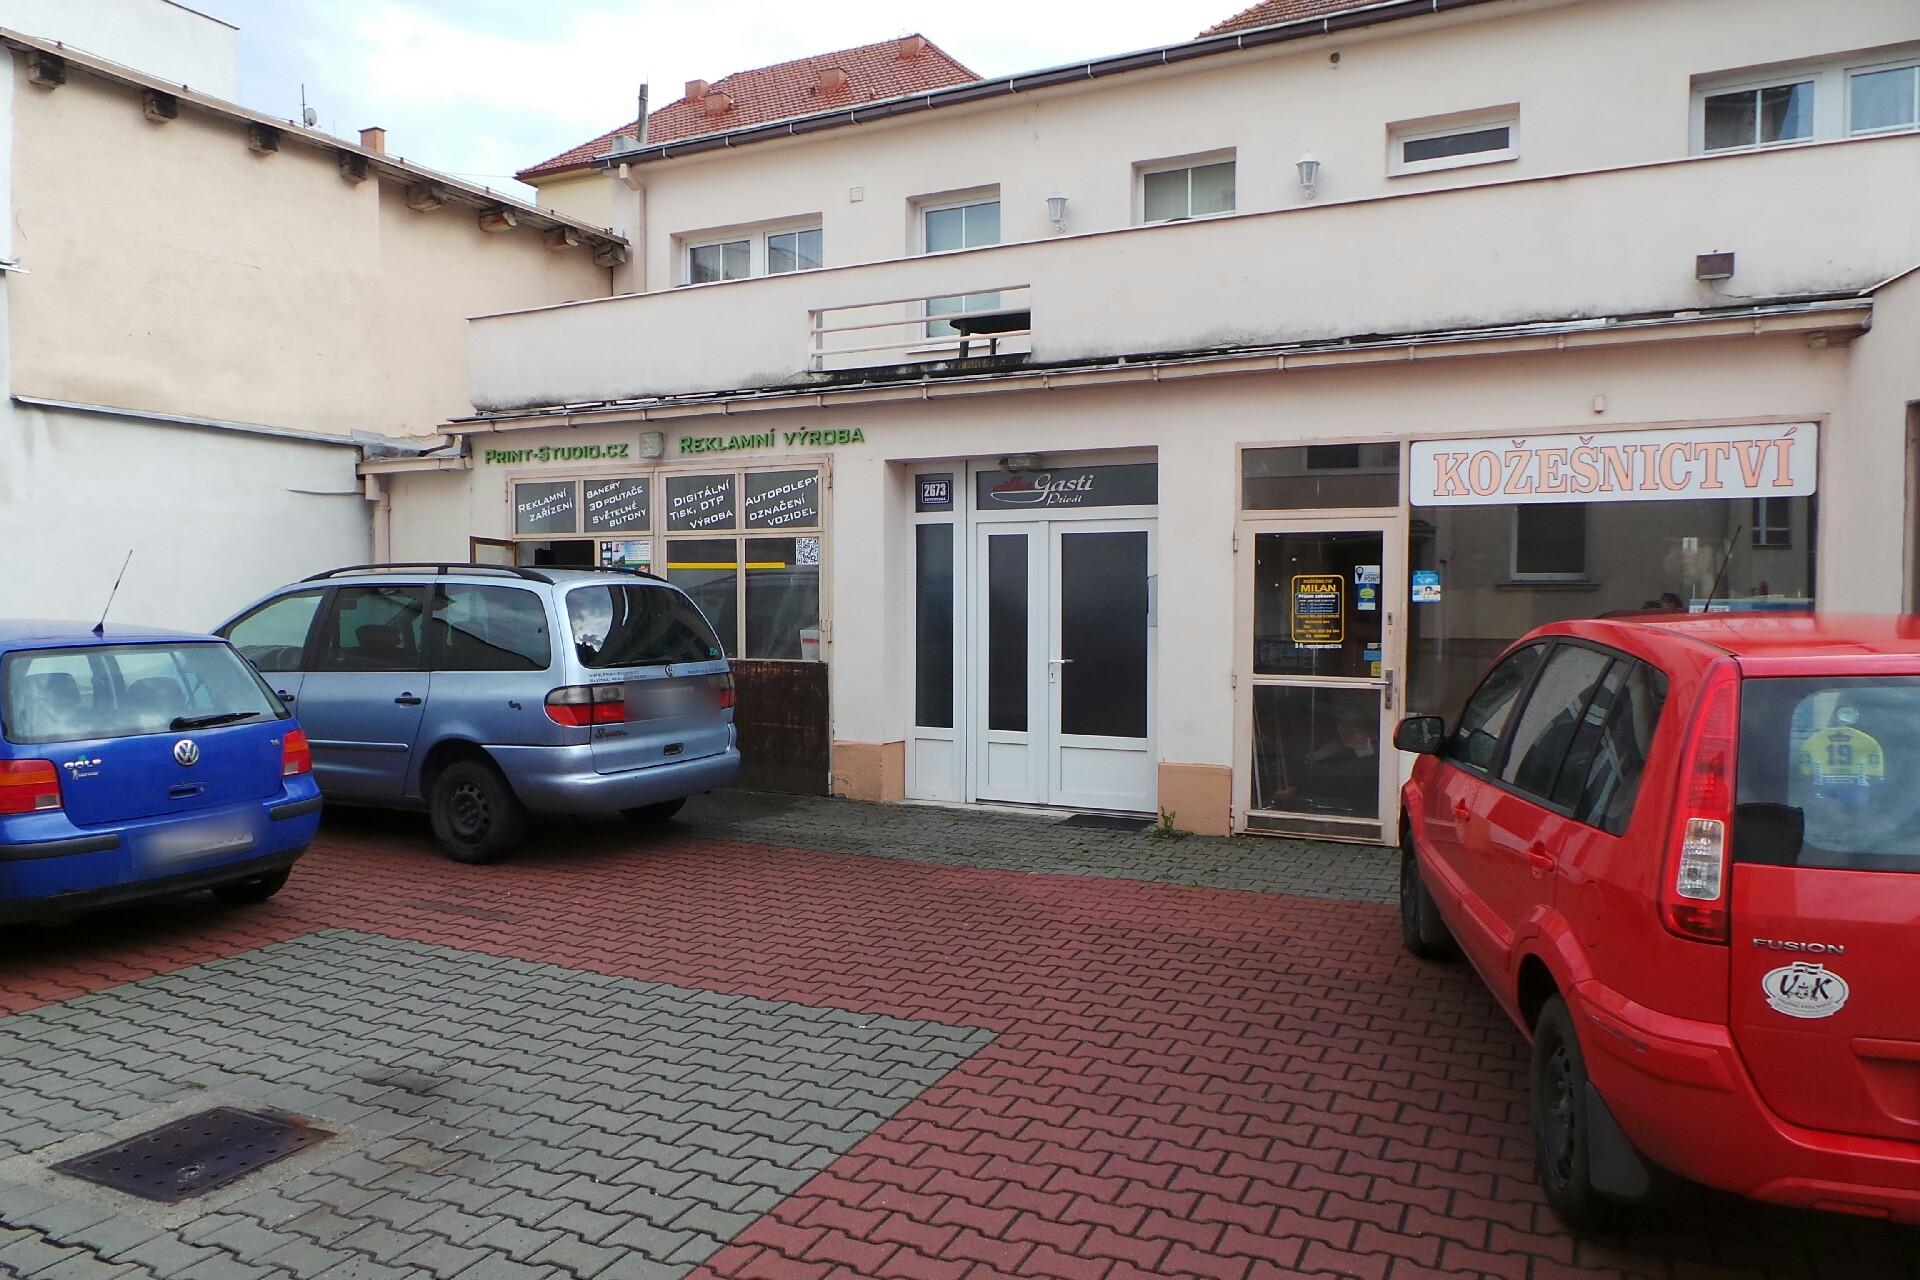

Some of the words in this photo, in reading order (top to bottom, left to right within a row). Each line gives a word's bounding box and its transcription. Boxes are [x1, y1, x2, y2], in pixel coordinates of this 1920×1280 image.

[679, 428, 775, 453] REKLAMNÍ
[784, 426, 864, 447] VÝROBA
[1433, 427, 1798, 496] KOŽEŠNICTVÍ
[518, 487, 567, 514] REKLAMNÍ
[586, 481, 621, 499] BANERY
[603, 485, 644, 507] POUTAČE
[673, 479, 730, 508] DIGITÁLNÍ
[745, 475, 818, 507] AUTOPOLEPY
[924, 483, 946, 497] 2673
[529, 498, 573, 522] ZAŘÍZENÍ
[592, 501, 638, 524] SVĚTELNÉ
[609, 508, 647, 528] BUTONY
[669, 506, 697, 521] TISK,
[700, 495, 724, 511] DTP
[749, 493, 805, 521] OZNAČENÍ
[767, 507, 816, 526] VOZIDEL
[689, 509, 733, 529] VÝROBA
[1301, 584, 1336, 592] MILAN
[1751, 938, 1845, 954] FUSION
